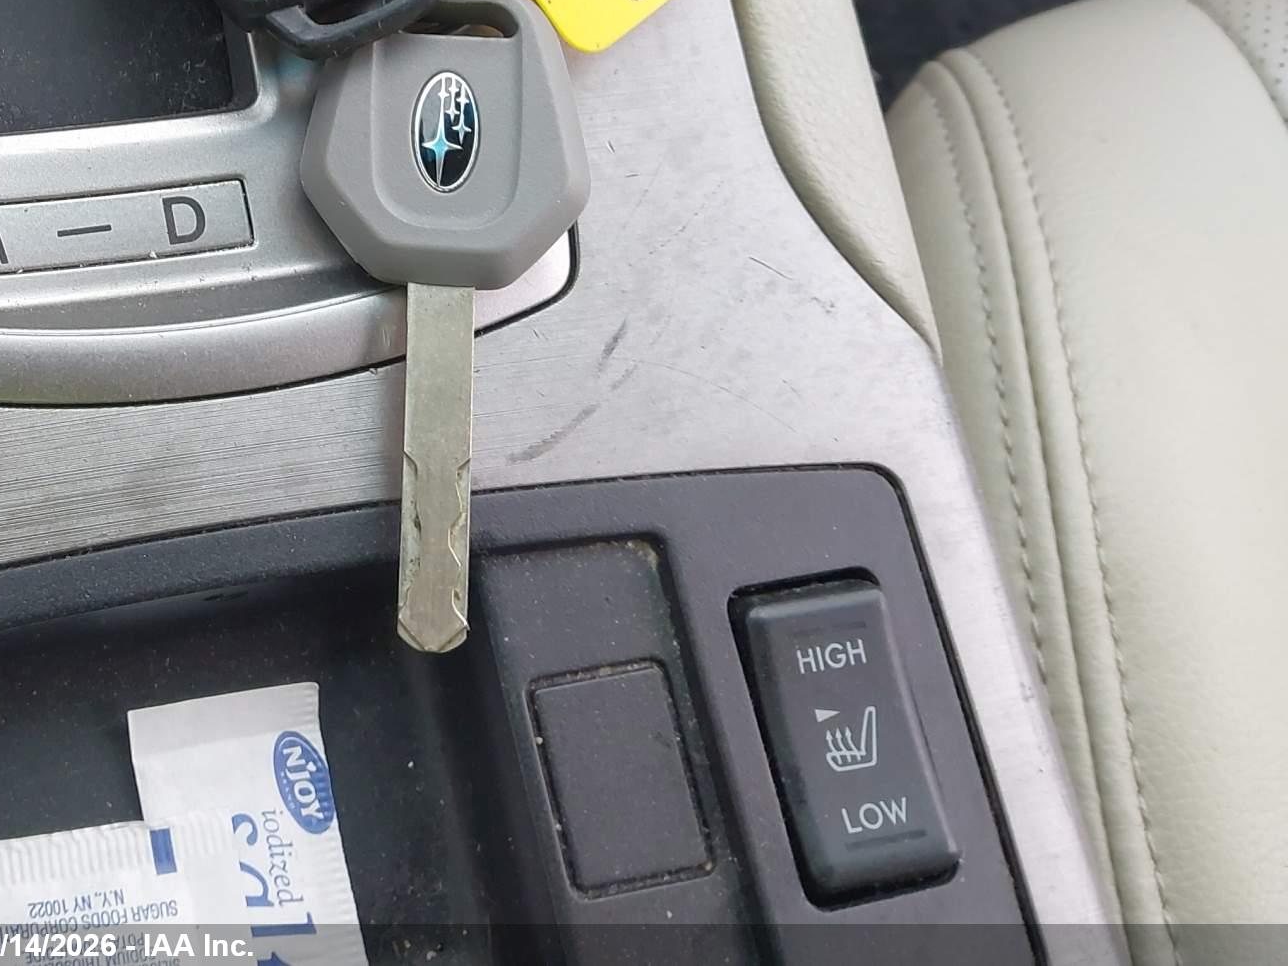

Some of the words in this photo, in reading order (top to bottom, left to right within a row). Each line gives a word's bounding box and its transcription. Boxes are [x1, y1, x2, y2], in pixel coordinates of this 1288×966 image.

[162, 196, 206, 245] D
[796, 639, 867, 674] HIGH
[841, 797, 907, 834] LOW
[261, 809, 305, 908] iodized
[28, 901, 67, 919] 10022
[73, 900, 92, 913] NY
[83, 907, 128, 930] FOODS
[132, 900, 178, 923] SUGAR
